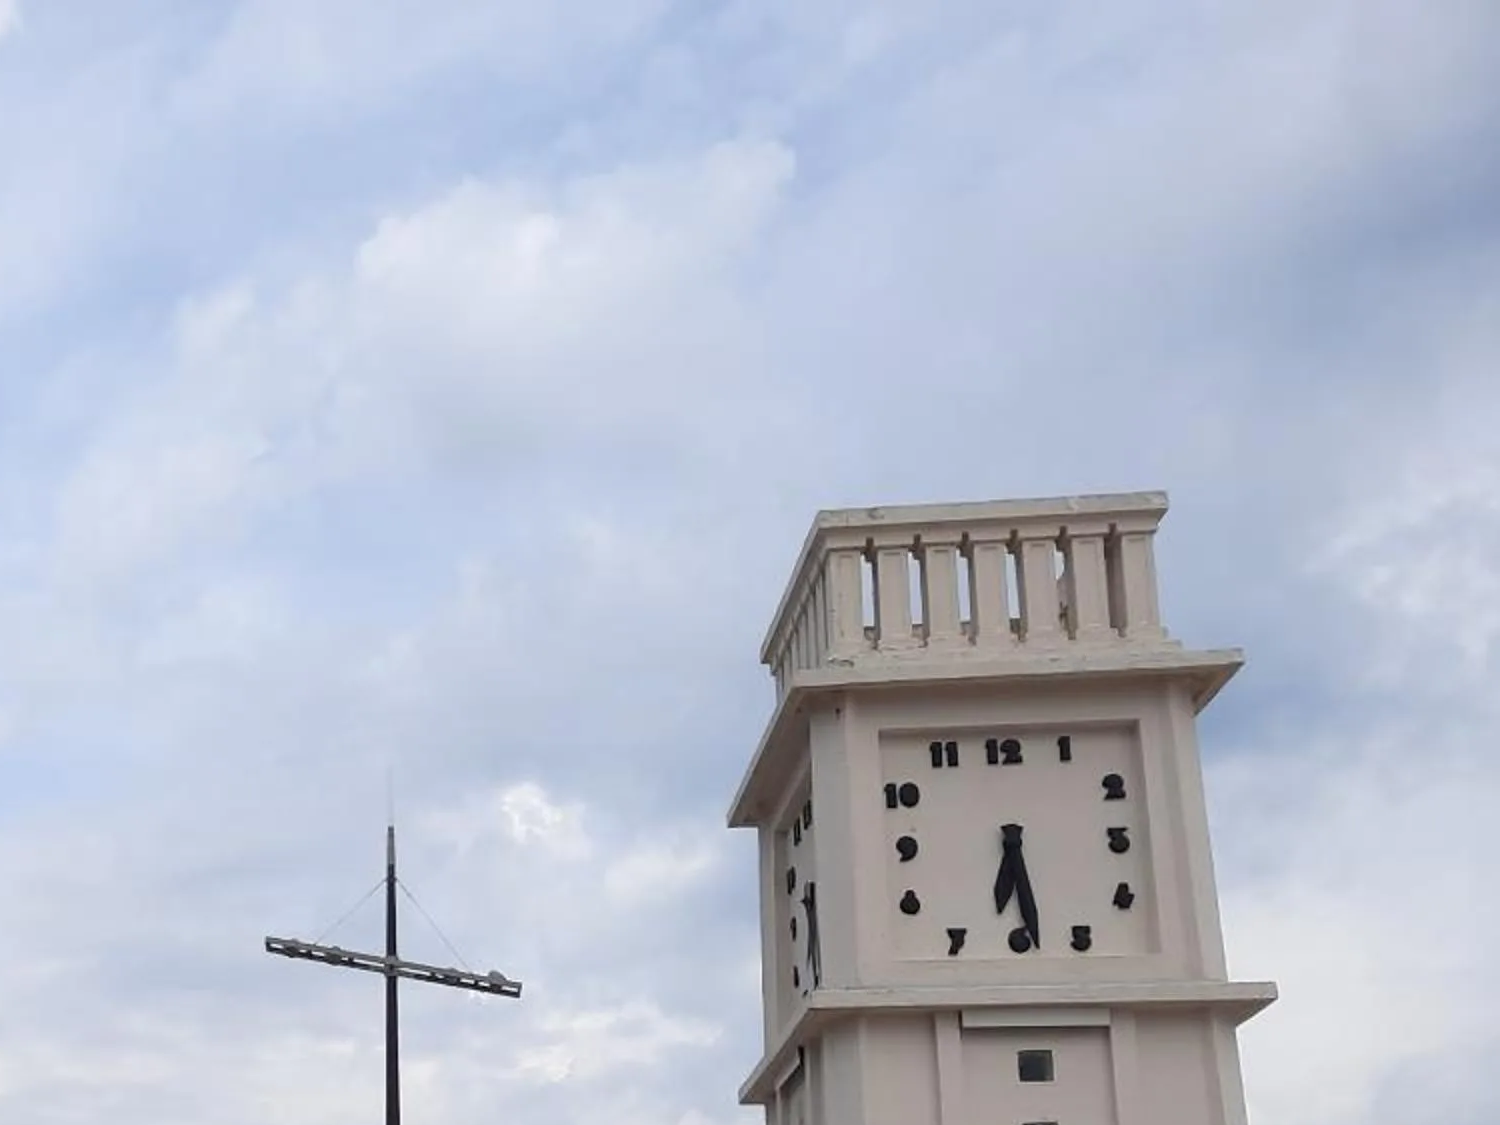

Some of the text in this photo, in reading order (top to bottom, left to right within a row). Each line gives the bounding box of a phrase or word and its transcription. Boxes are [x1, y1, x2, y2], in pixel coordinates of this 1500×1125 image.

[929, 741, 959, 768] 11
[986, 738, 1023, 765] 12
[1057, 736, 1072, 762] 1
[884, 782, 920, 809] 10
[1102, 774, 1127, 800] 2
[896, 836, 918, 862] 9
[1107, 827, 1130, 854] 3
[1113, 883, 1134, 910] 4
[947, 928, 967, 956] 7
[1008, 927, 1031, 954] 6
[1070, 925, 1092, 952] 5
